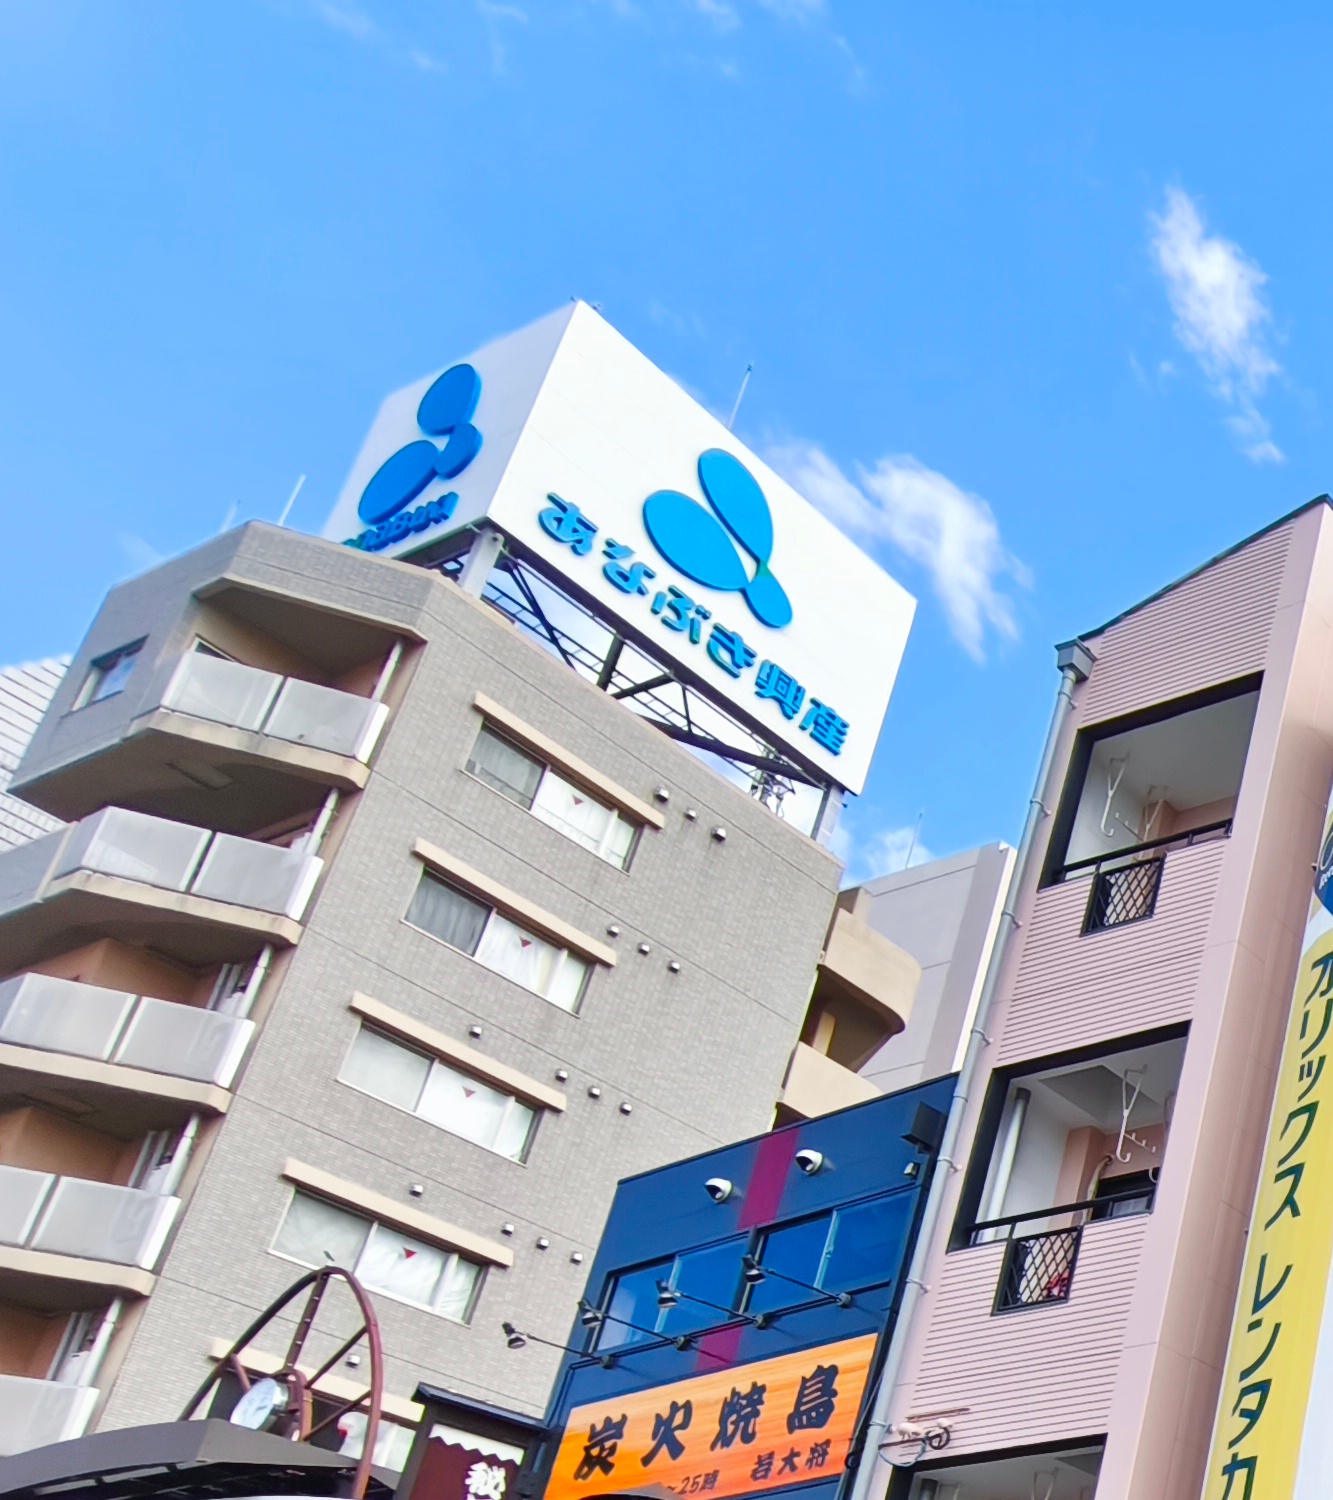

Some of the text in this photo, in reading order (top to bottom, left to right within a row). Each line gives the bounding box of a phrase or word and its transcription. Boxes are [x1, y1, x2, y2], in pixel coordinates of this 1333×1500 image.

[538, 492, 851, 757] あなぶき興産
[574, 1363, 839, 1481] 炭火焼鳥
[749, 1438, 831, 1481] 若大将
